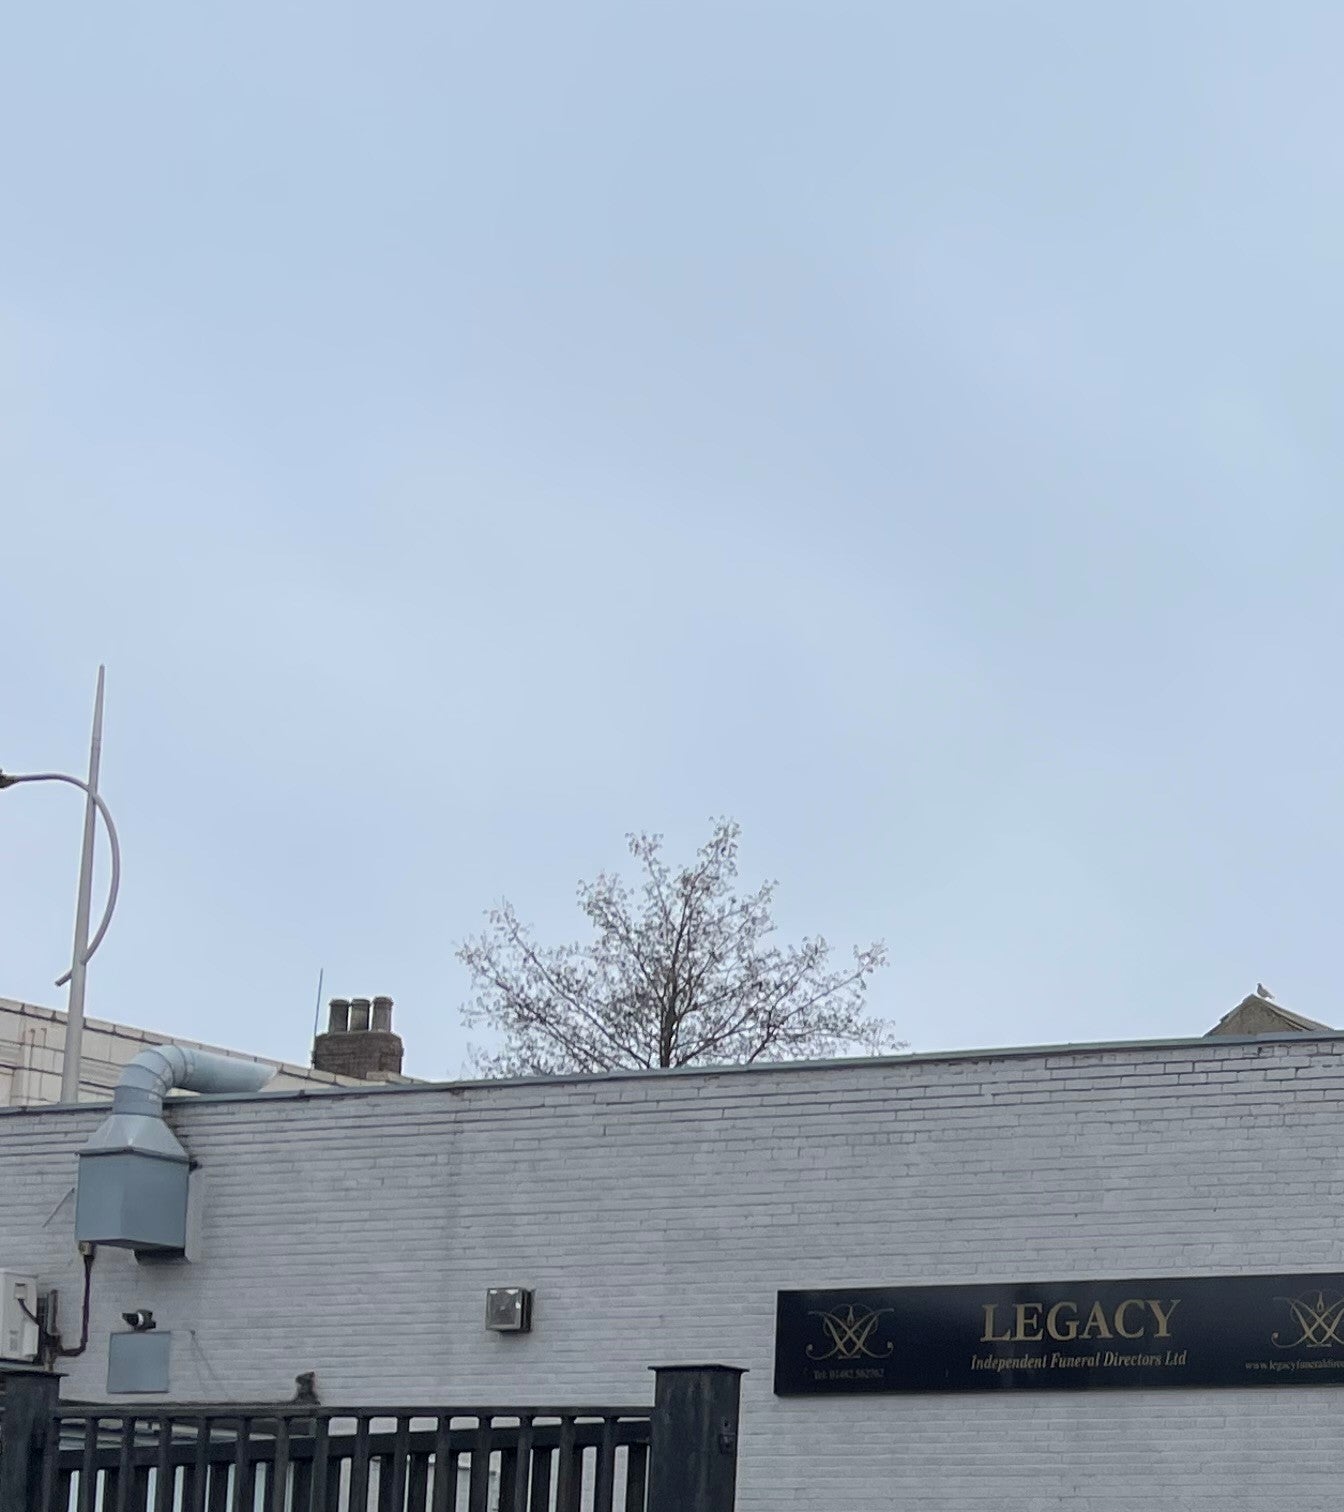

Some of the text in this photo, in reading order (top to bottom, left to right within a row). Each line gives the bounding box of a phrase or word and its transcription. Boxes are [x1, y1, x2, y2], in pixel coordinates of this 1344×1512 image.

[980, 1299, 1182, 1342] LEGACY
[971, 1350, 1187, 1372] Independent Funeral Directors Ltd
